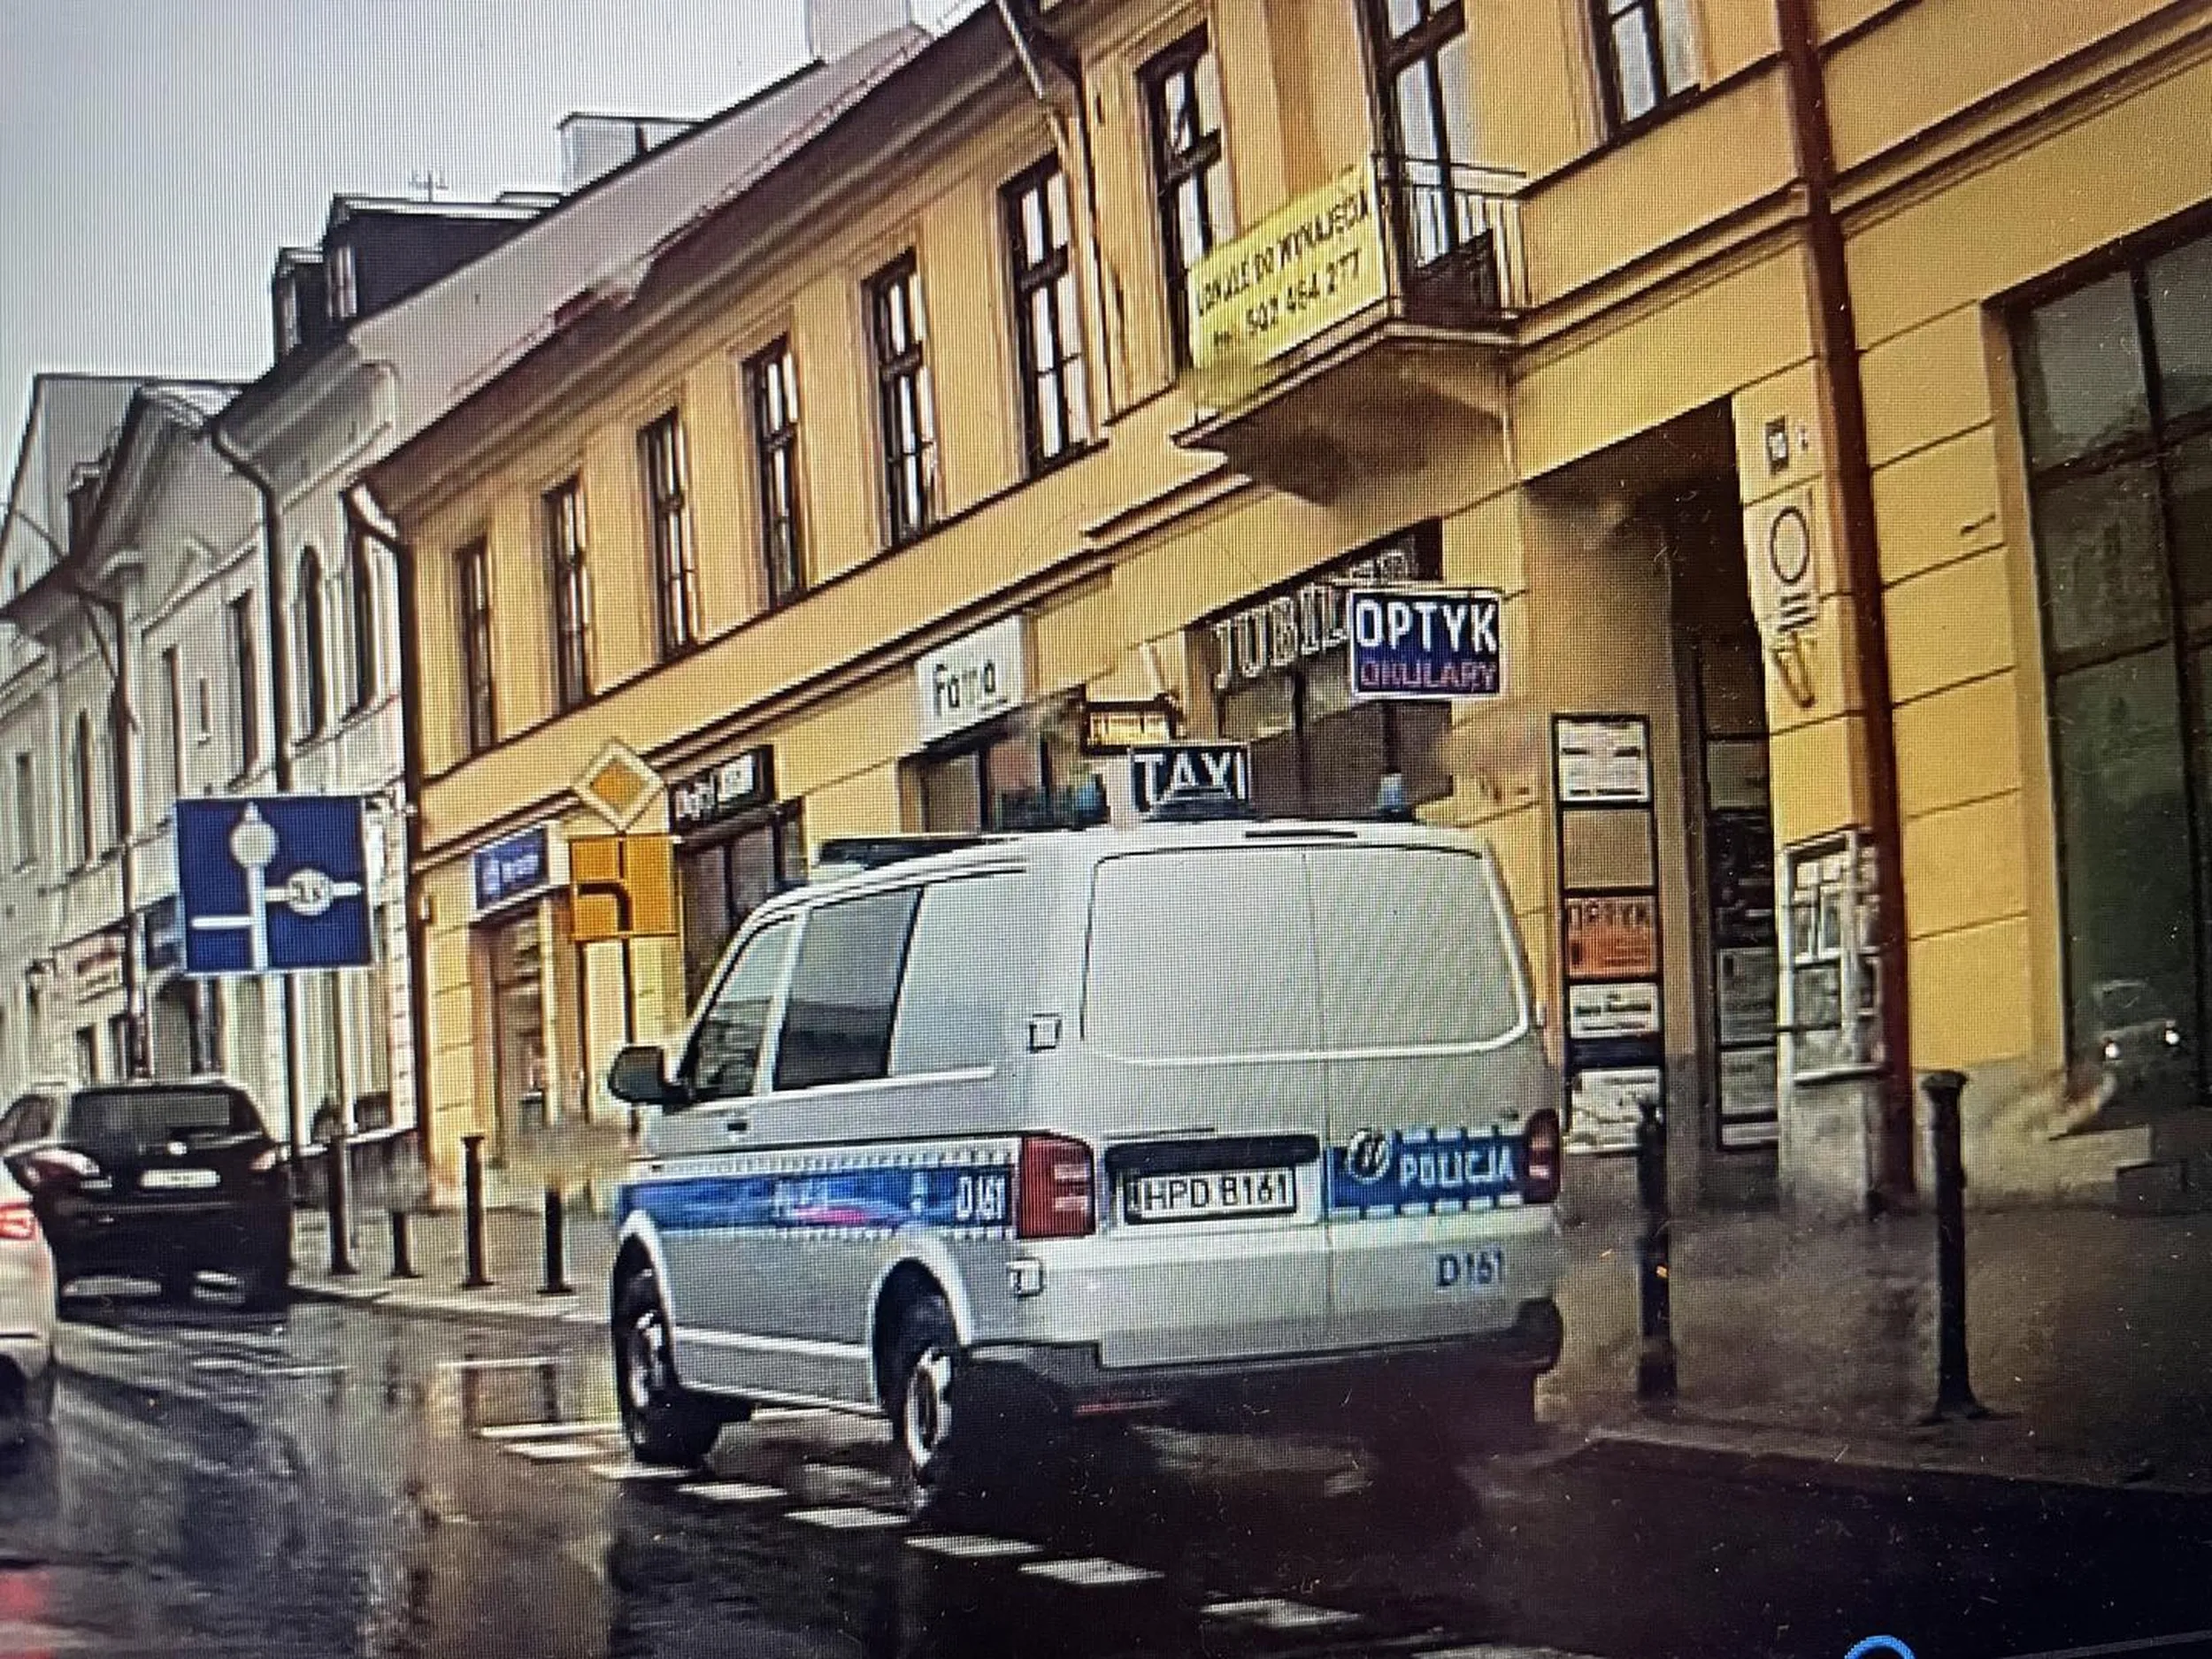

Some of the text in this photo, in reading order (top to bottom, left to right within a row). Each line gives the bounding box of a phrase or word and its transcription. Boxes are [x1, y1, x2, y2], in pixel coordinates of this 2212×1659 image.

[1354, 598, 1498, 655] OPTYK
[1359, 659, 1497, 693] OKULARY
[1399, 1145, 1516, 1188] POLICJA
[1144, 1178, 1211, 1211] HPD
